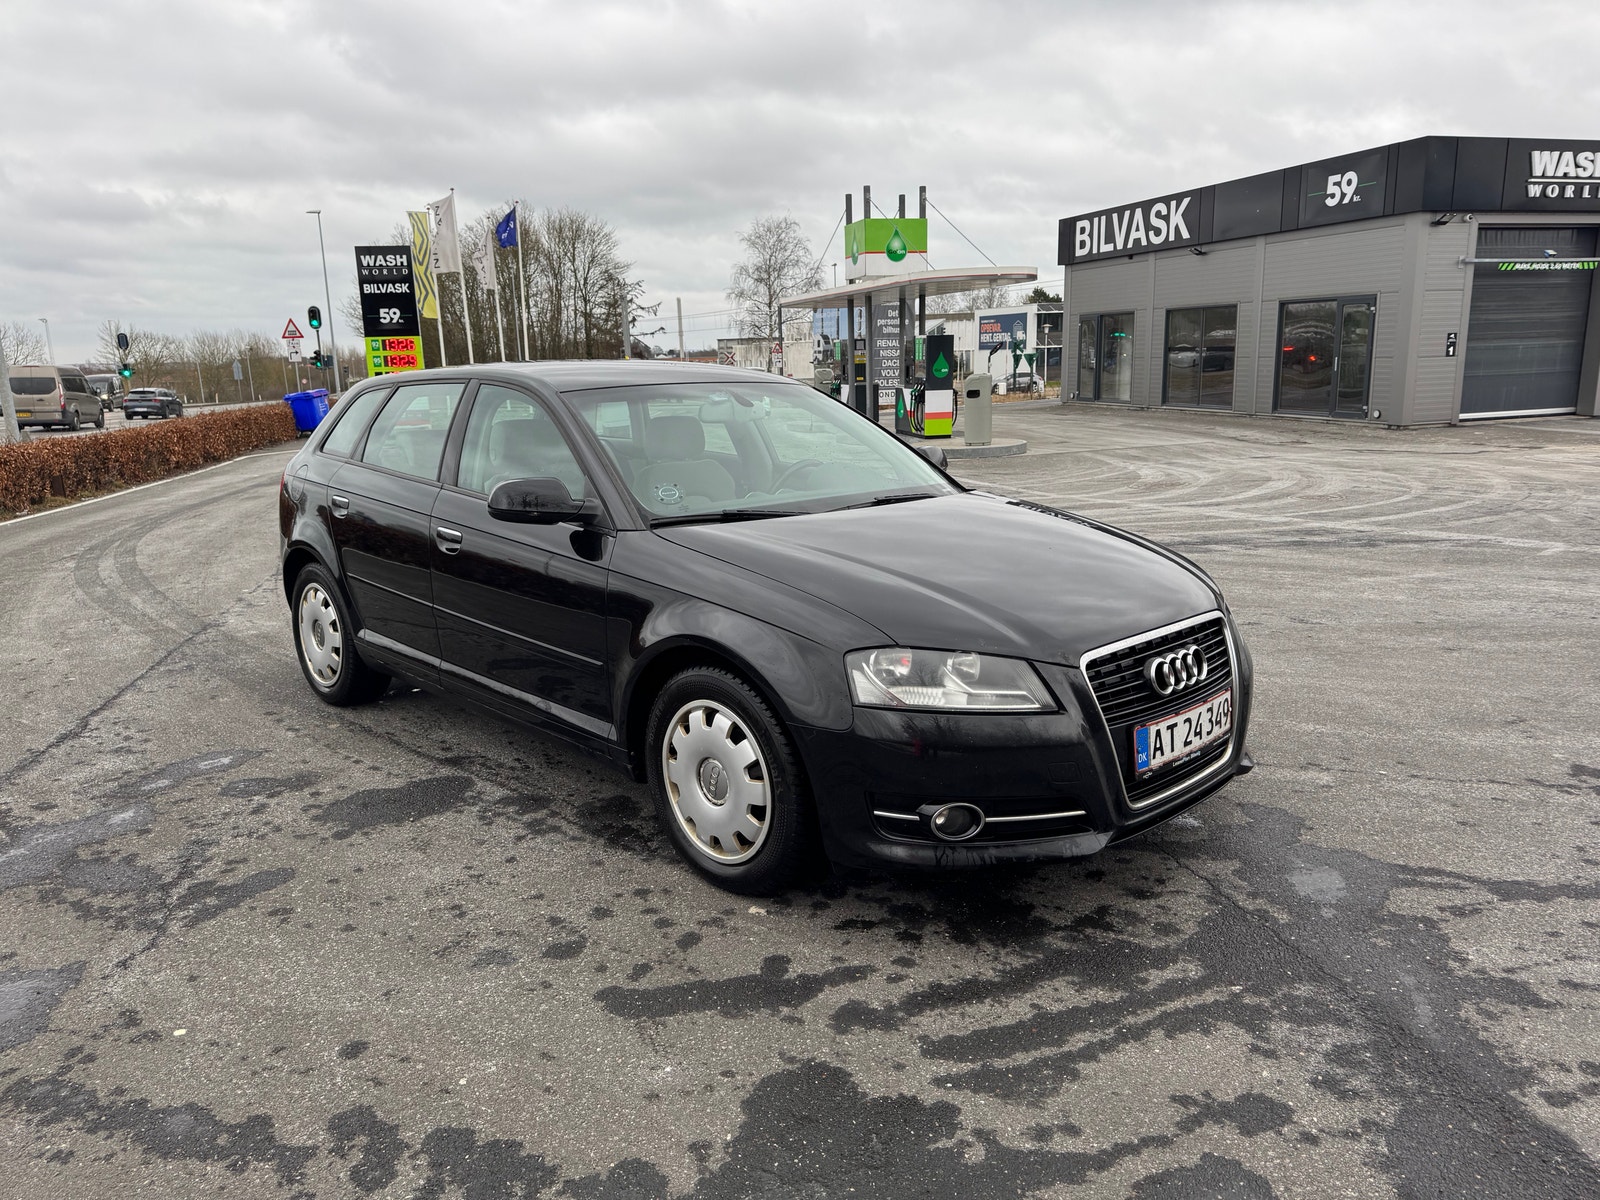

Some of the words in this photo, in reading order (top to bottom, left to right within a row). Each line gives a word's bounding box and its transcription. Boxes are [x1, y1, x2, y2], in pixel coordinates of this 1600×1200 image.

[1325, 171, 1358, 207] 59
[1527, 184, 1600, 199] WORL
[1075, 197, 1192, 257] BILVASK
[360, 255, 408, 266] WASH
[363, 283, 410, 294] BILVASK
[379, 308, 401, 323] 59
[887, 309, 899, 318] Det
[1152, 722, 1178, 759] AT
[1183, 711, 1203, 747] 24
[1206, 697, 1230, 736] 349
[1138, 752, 1147, 763] DK
